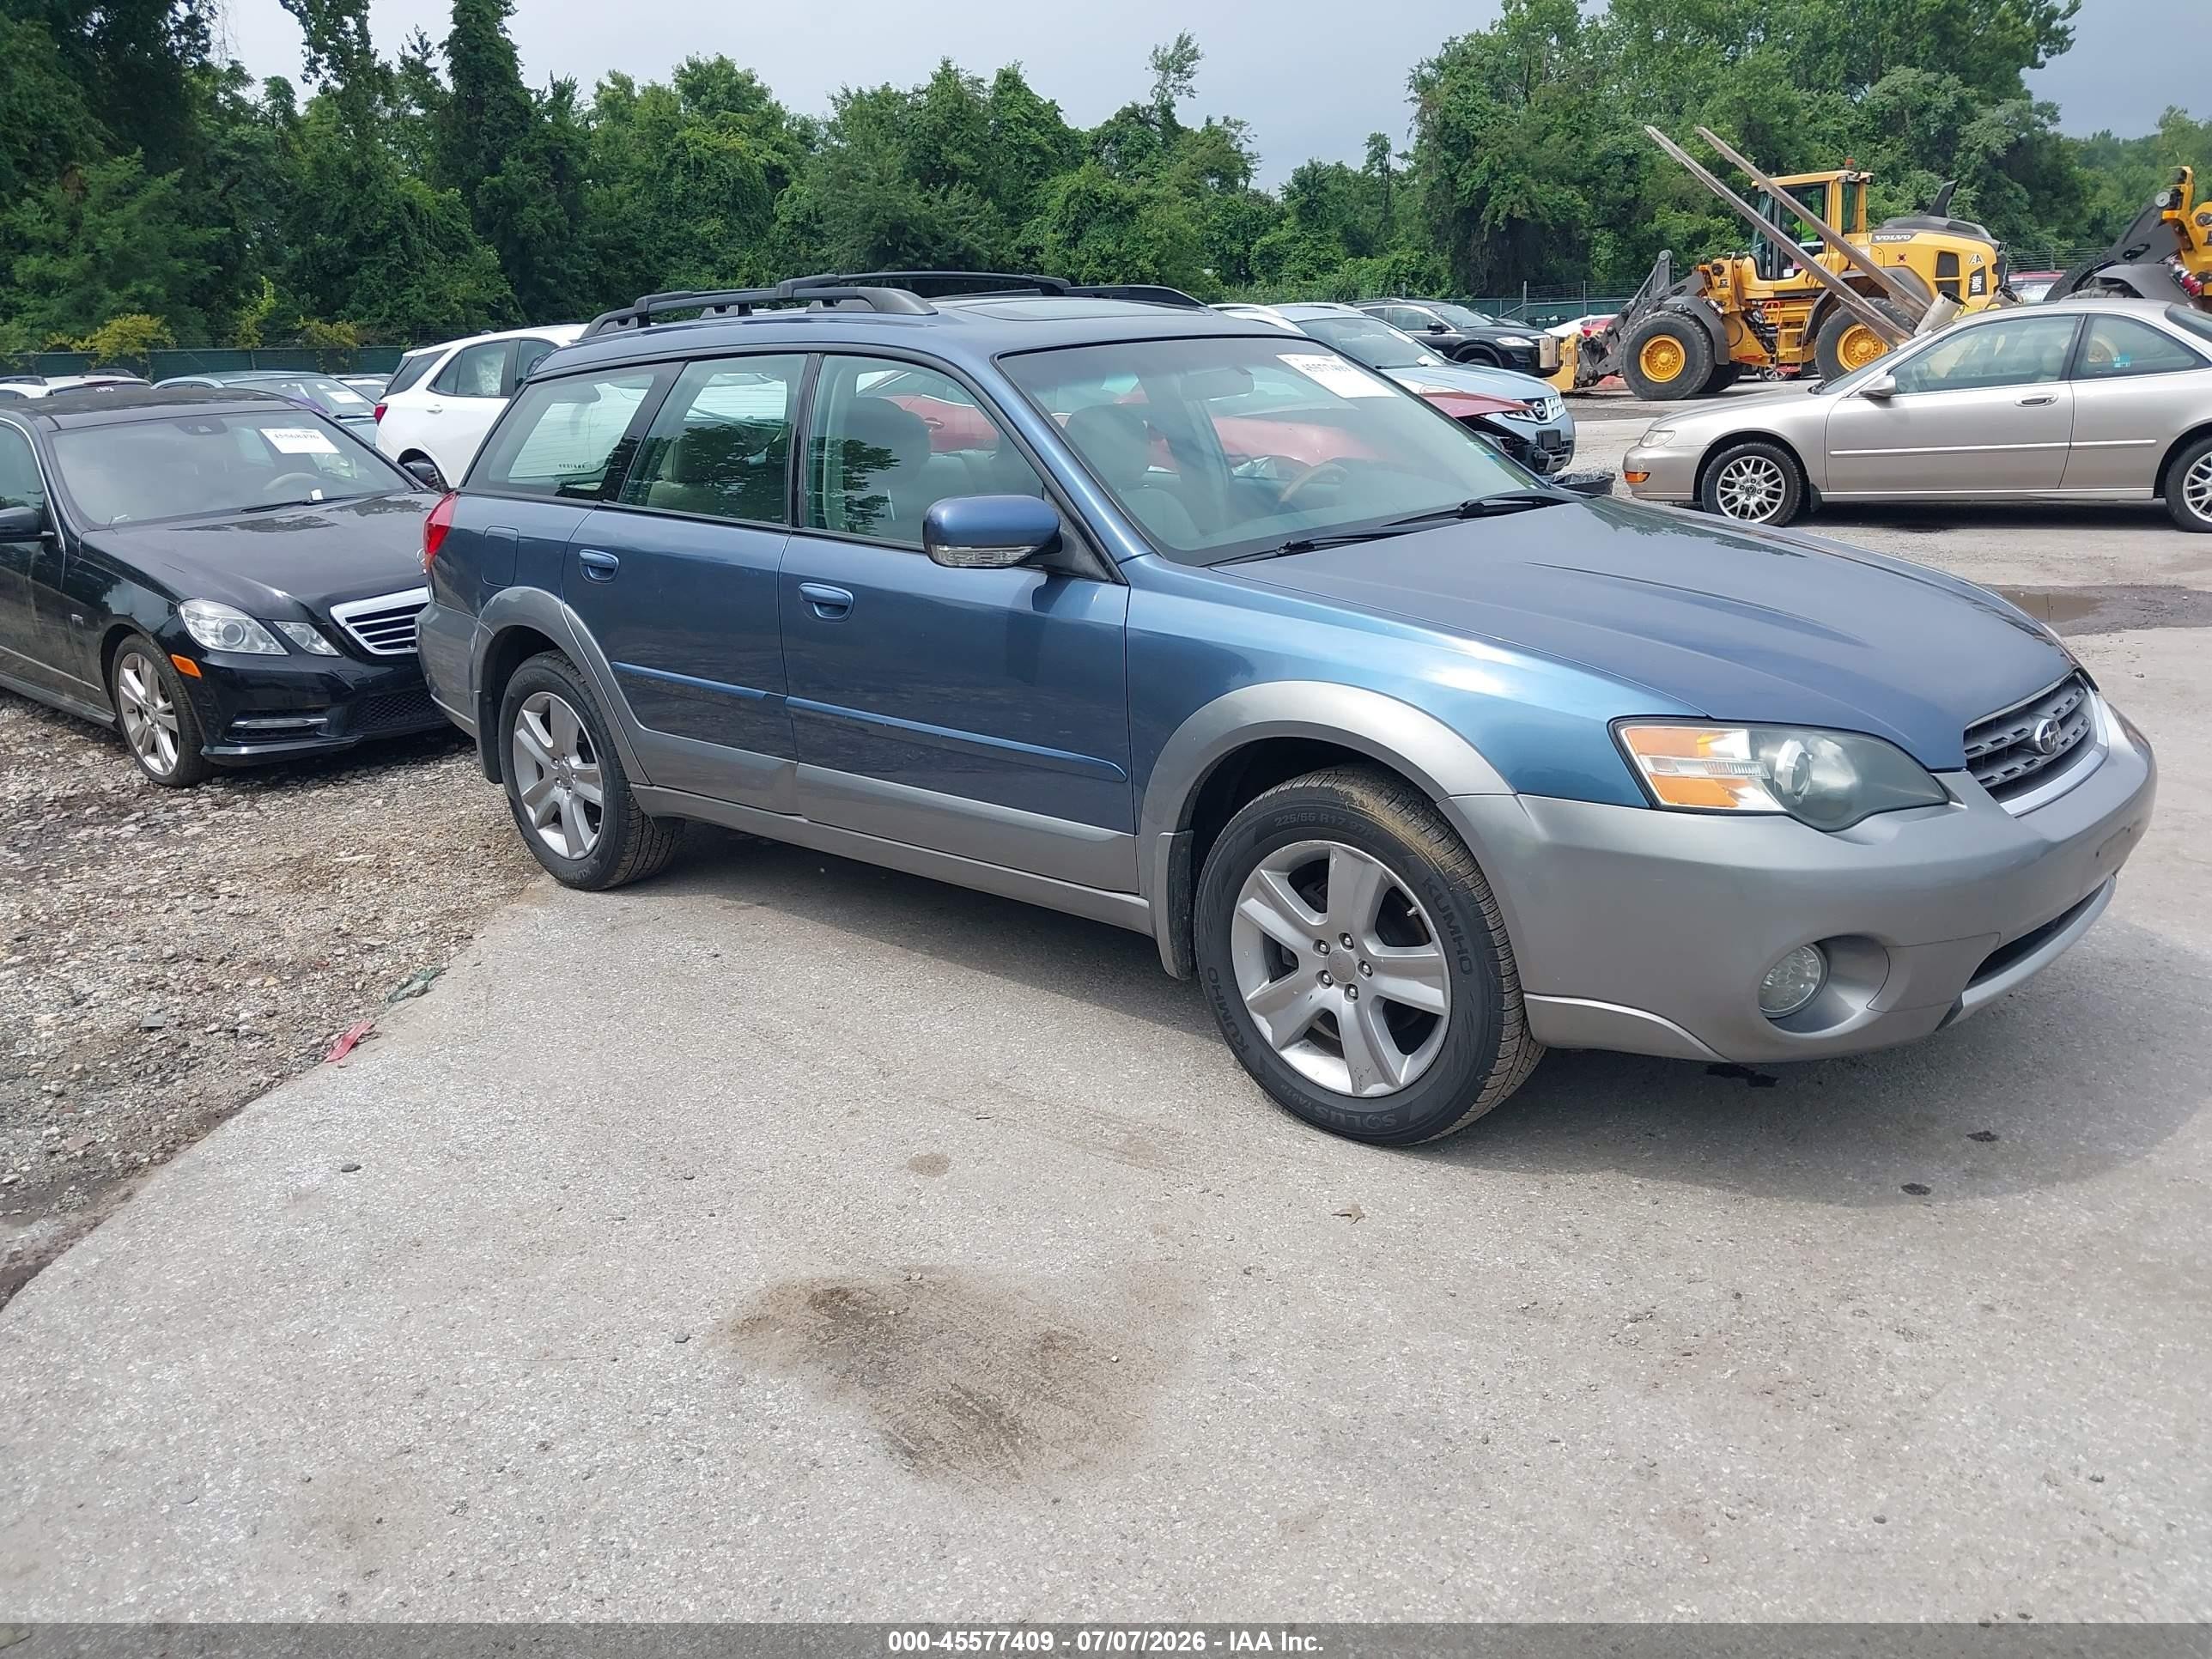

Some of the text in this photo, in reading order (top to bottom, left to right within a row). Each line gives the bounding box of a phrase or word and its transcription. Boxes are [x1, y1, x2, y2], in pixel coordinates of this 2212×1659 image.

[1422, 877, 1474, 975] KUMHO
[1207, 967, 1249, 1053] KUMHO
[1315, 1105, 1397, 1129] SOLUS
